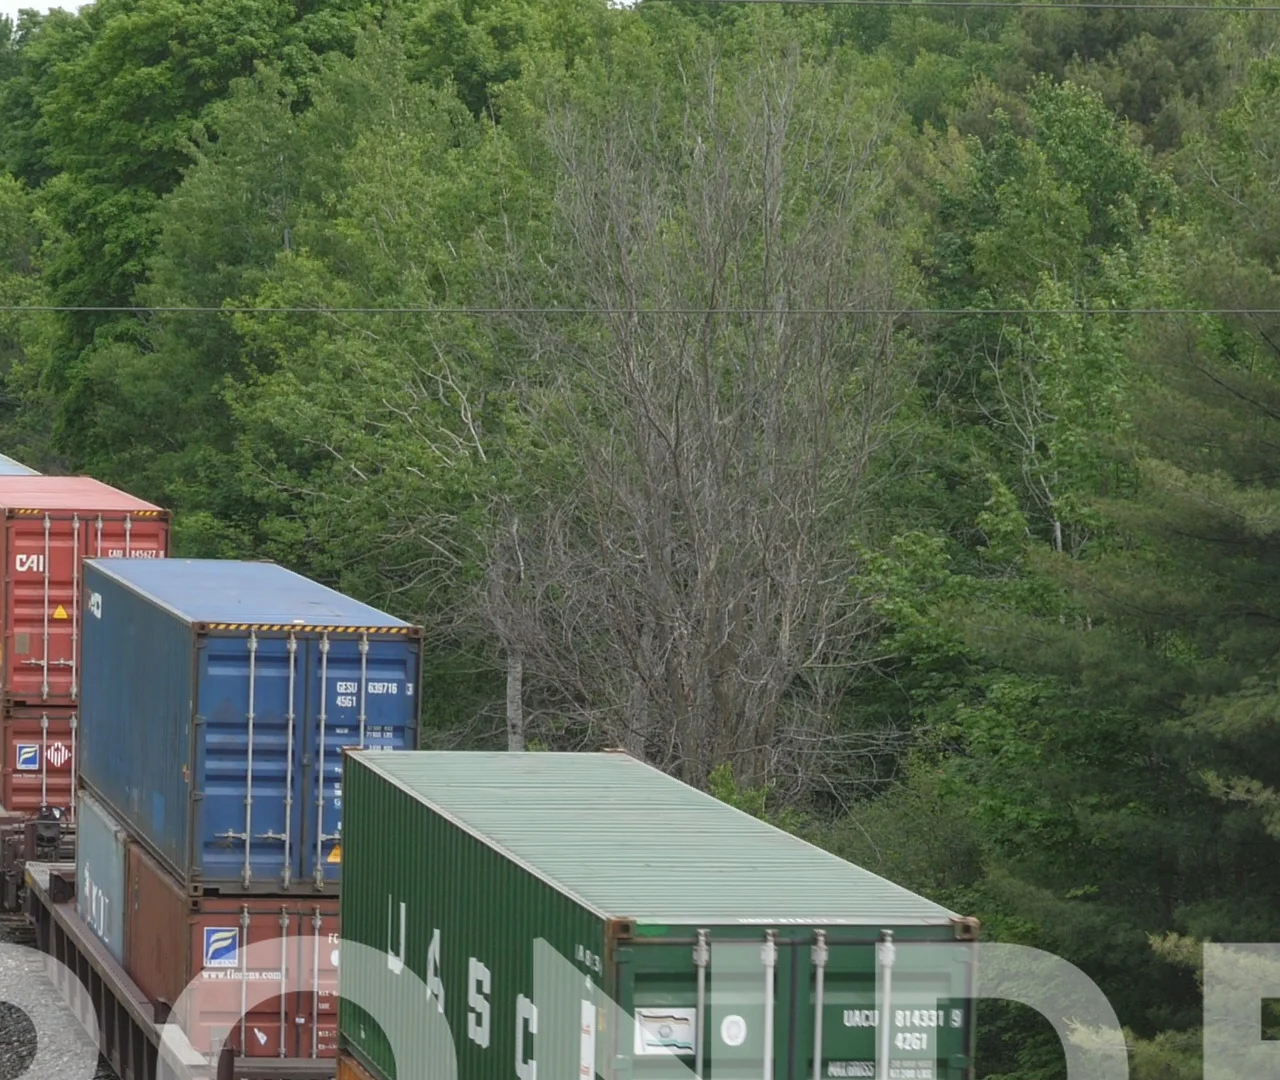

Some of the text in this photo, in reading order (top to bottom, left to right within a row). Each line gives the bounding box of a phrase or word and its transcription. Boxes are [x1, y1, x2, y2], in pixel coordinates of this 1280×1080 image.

[16, 554, 44, 572] CAI
[336, 682, 413, 695] GESU 639716 3
[843, 1010, 880, 1027] UACU
[895, 1010, 944, 1027] 814331
